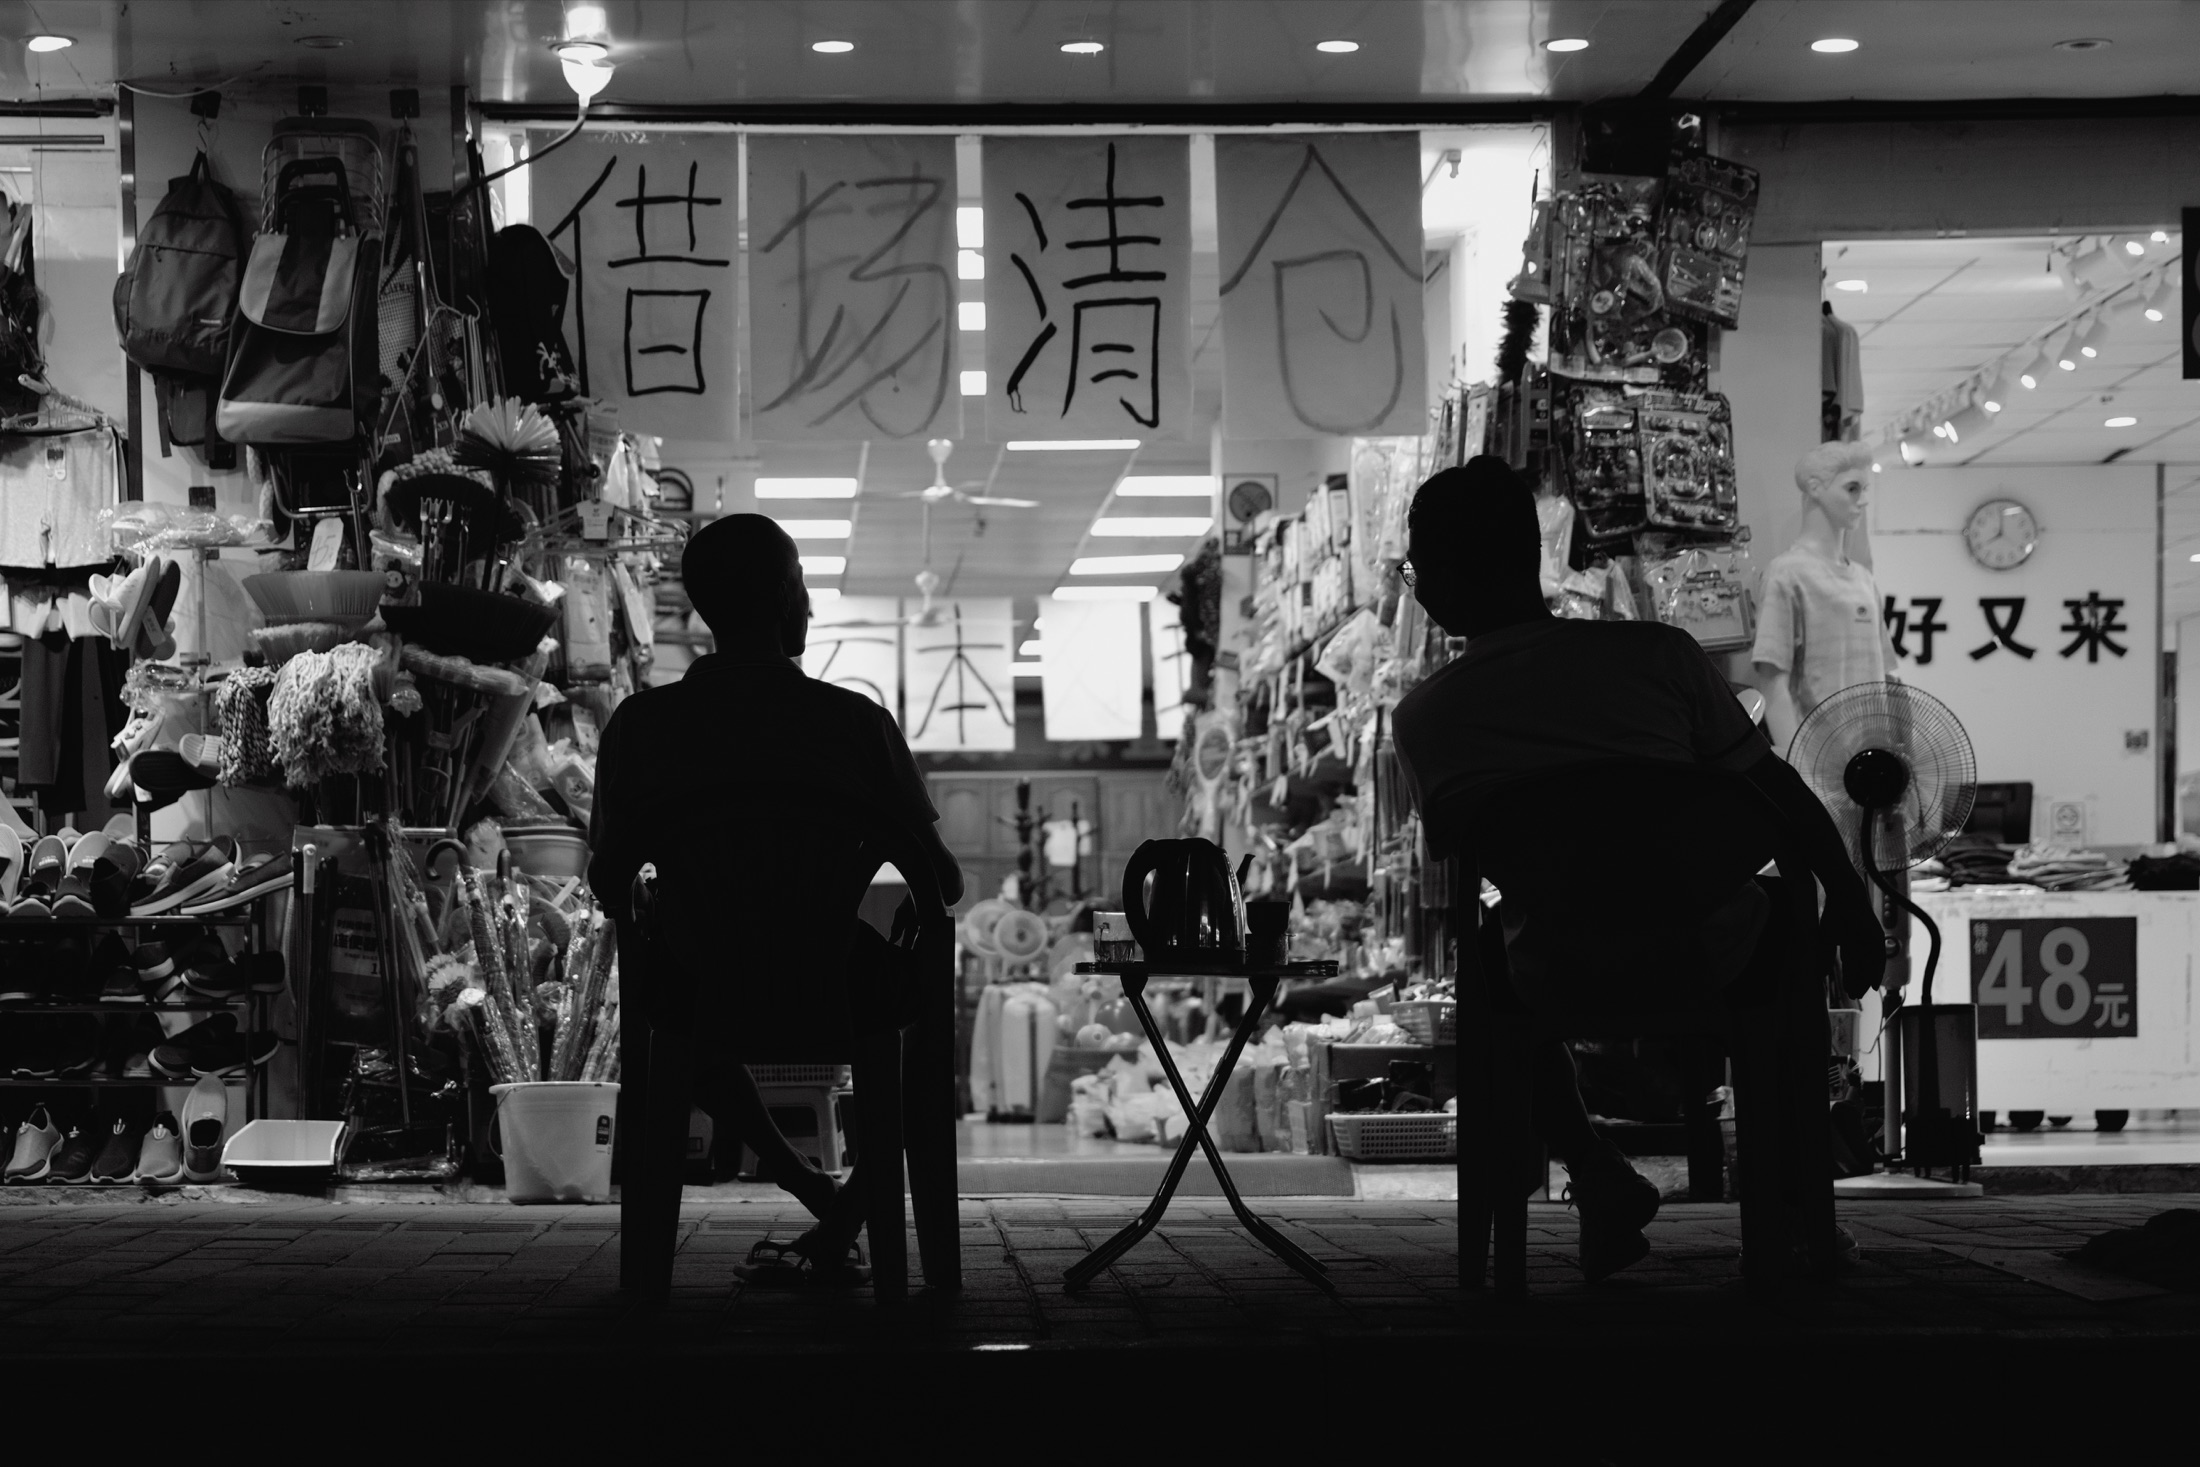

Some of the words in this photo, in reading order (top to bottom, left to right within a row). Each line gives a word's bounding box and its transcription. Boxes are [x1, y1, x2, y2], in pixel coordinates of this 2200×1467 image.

[1884, 592, 2127, 664] 好又来
[1977, 926, 2130, 1029] 48元
